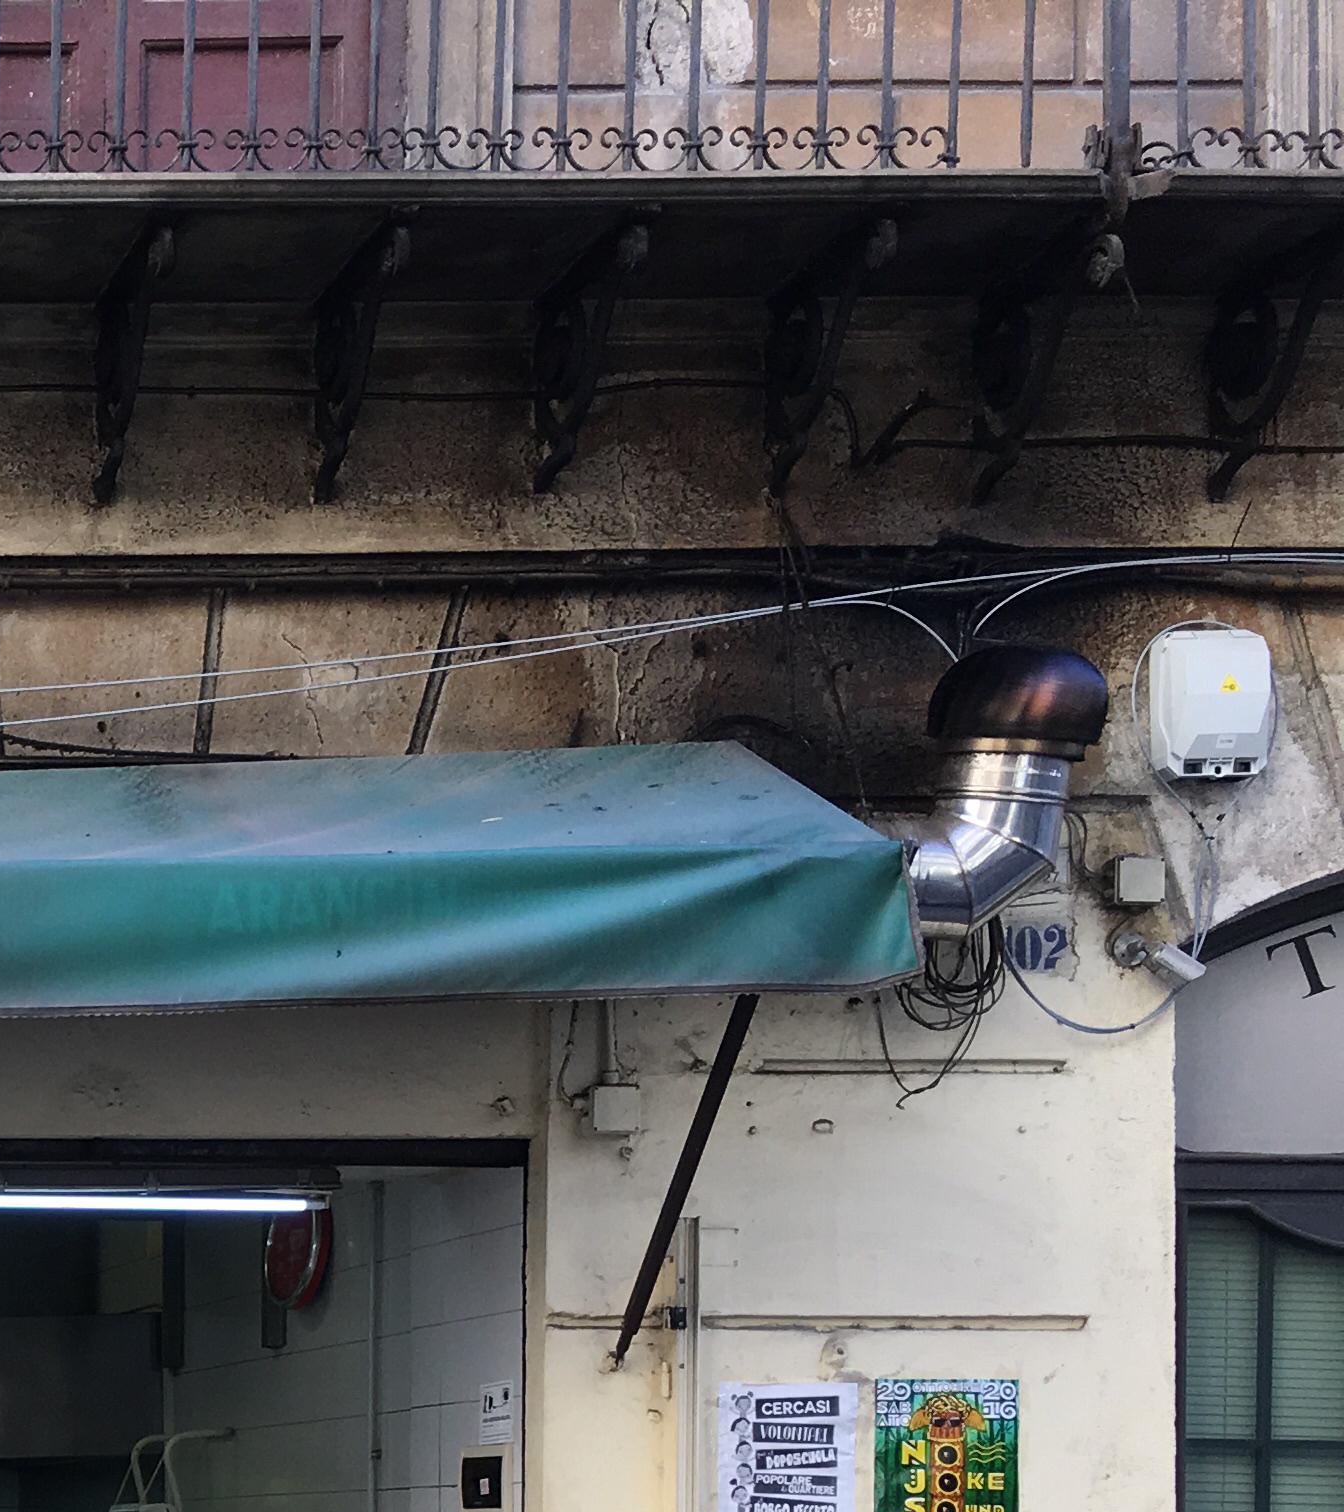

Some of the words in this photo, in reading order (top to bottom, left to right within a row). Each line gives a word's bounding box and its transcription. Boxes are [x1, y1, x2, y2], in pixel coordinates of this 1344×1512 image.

[1005, 925, 1068, 971] 02
[1266, 925, 1337, 999] T
[876, 1383, 911, 1400] 29
[983, 1383, 1017, 1400] 20
[761, 1400, 831, 1416] CERCASI
[983, 1401, 1017, 1419] 16
[755, 1474, 813, 1486] POPOLARE
